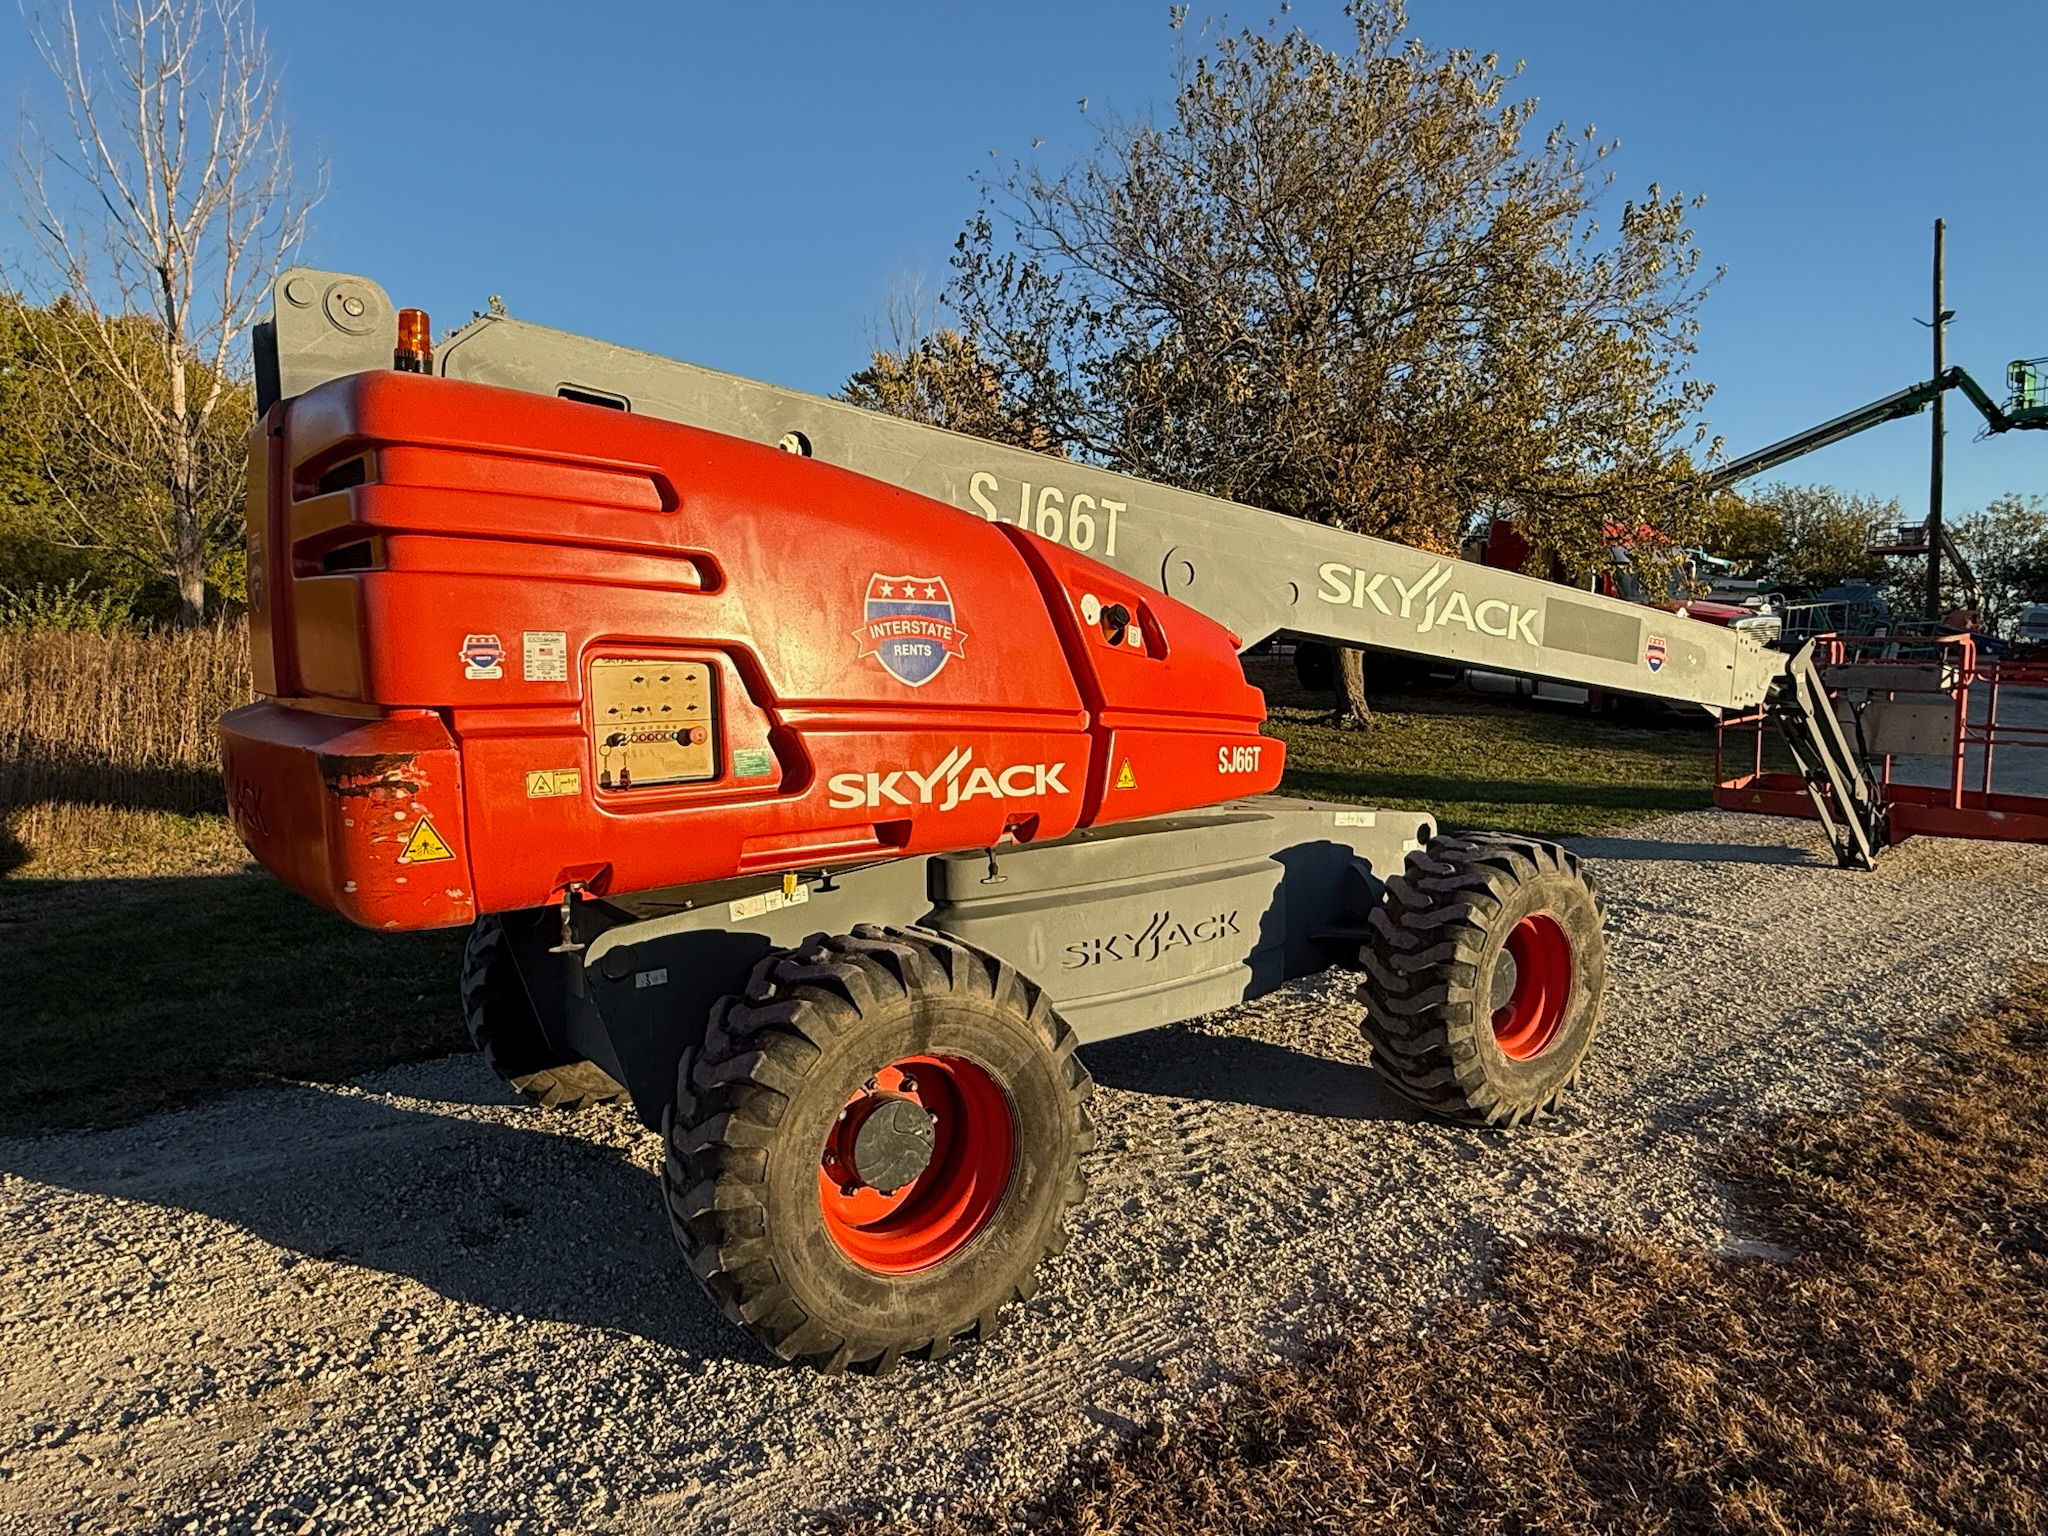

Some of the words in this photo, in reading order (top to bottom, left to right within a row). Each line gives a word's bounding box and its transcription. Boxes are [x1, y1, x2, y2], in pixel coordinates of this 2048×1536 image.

[1317, 561, 1539, 647] SKYJACK
[869, 620, 953, 640] INTERSTATE
[893, 643, 932, 657] RENTS
[827, 745, 1070, 812] SKYJACK
[1218, 746, 1262, 774] SJ66T
[1061, 910, 1241, 970] SKYJACK
